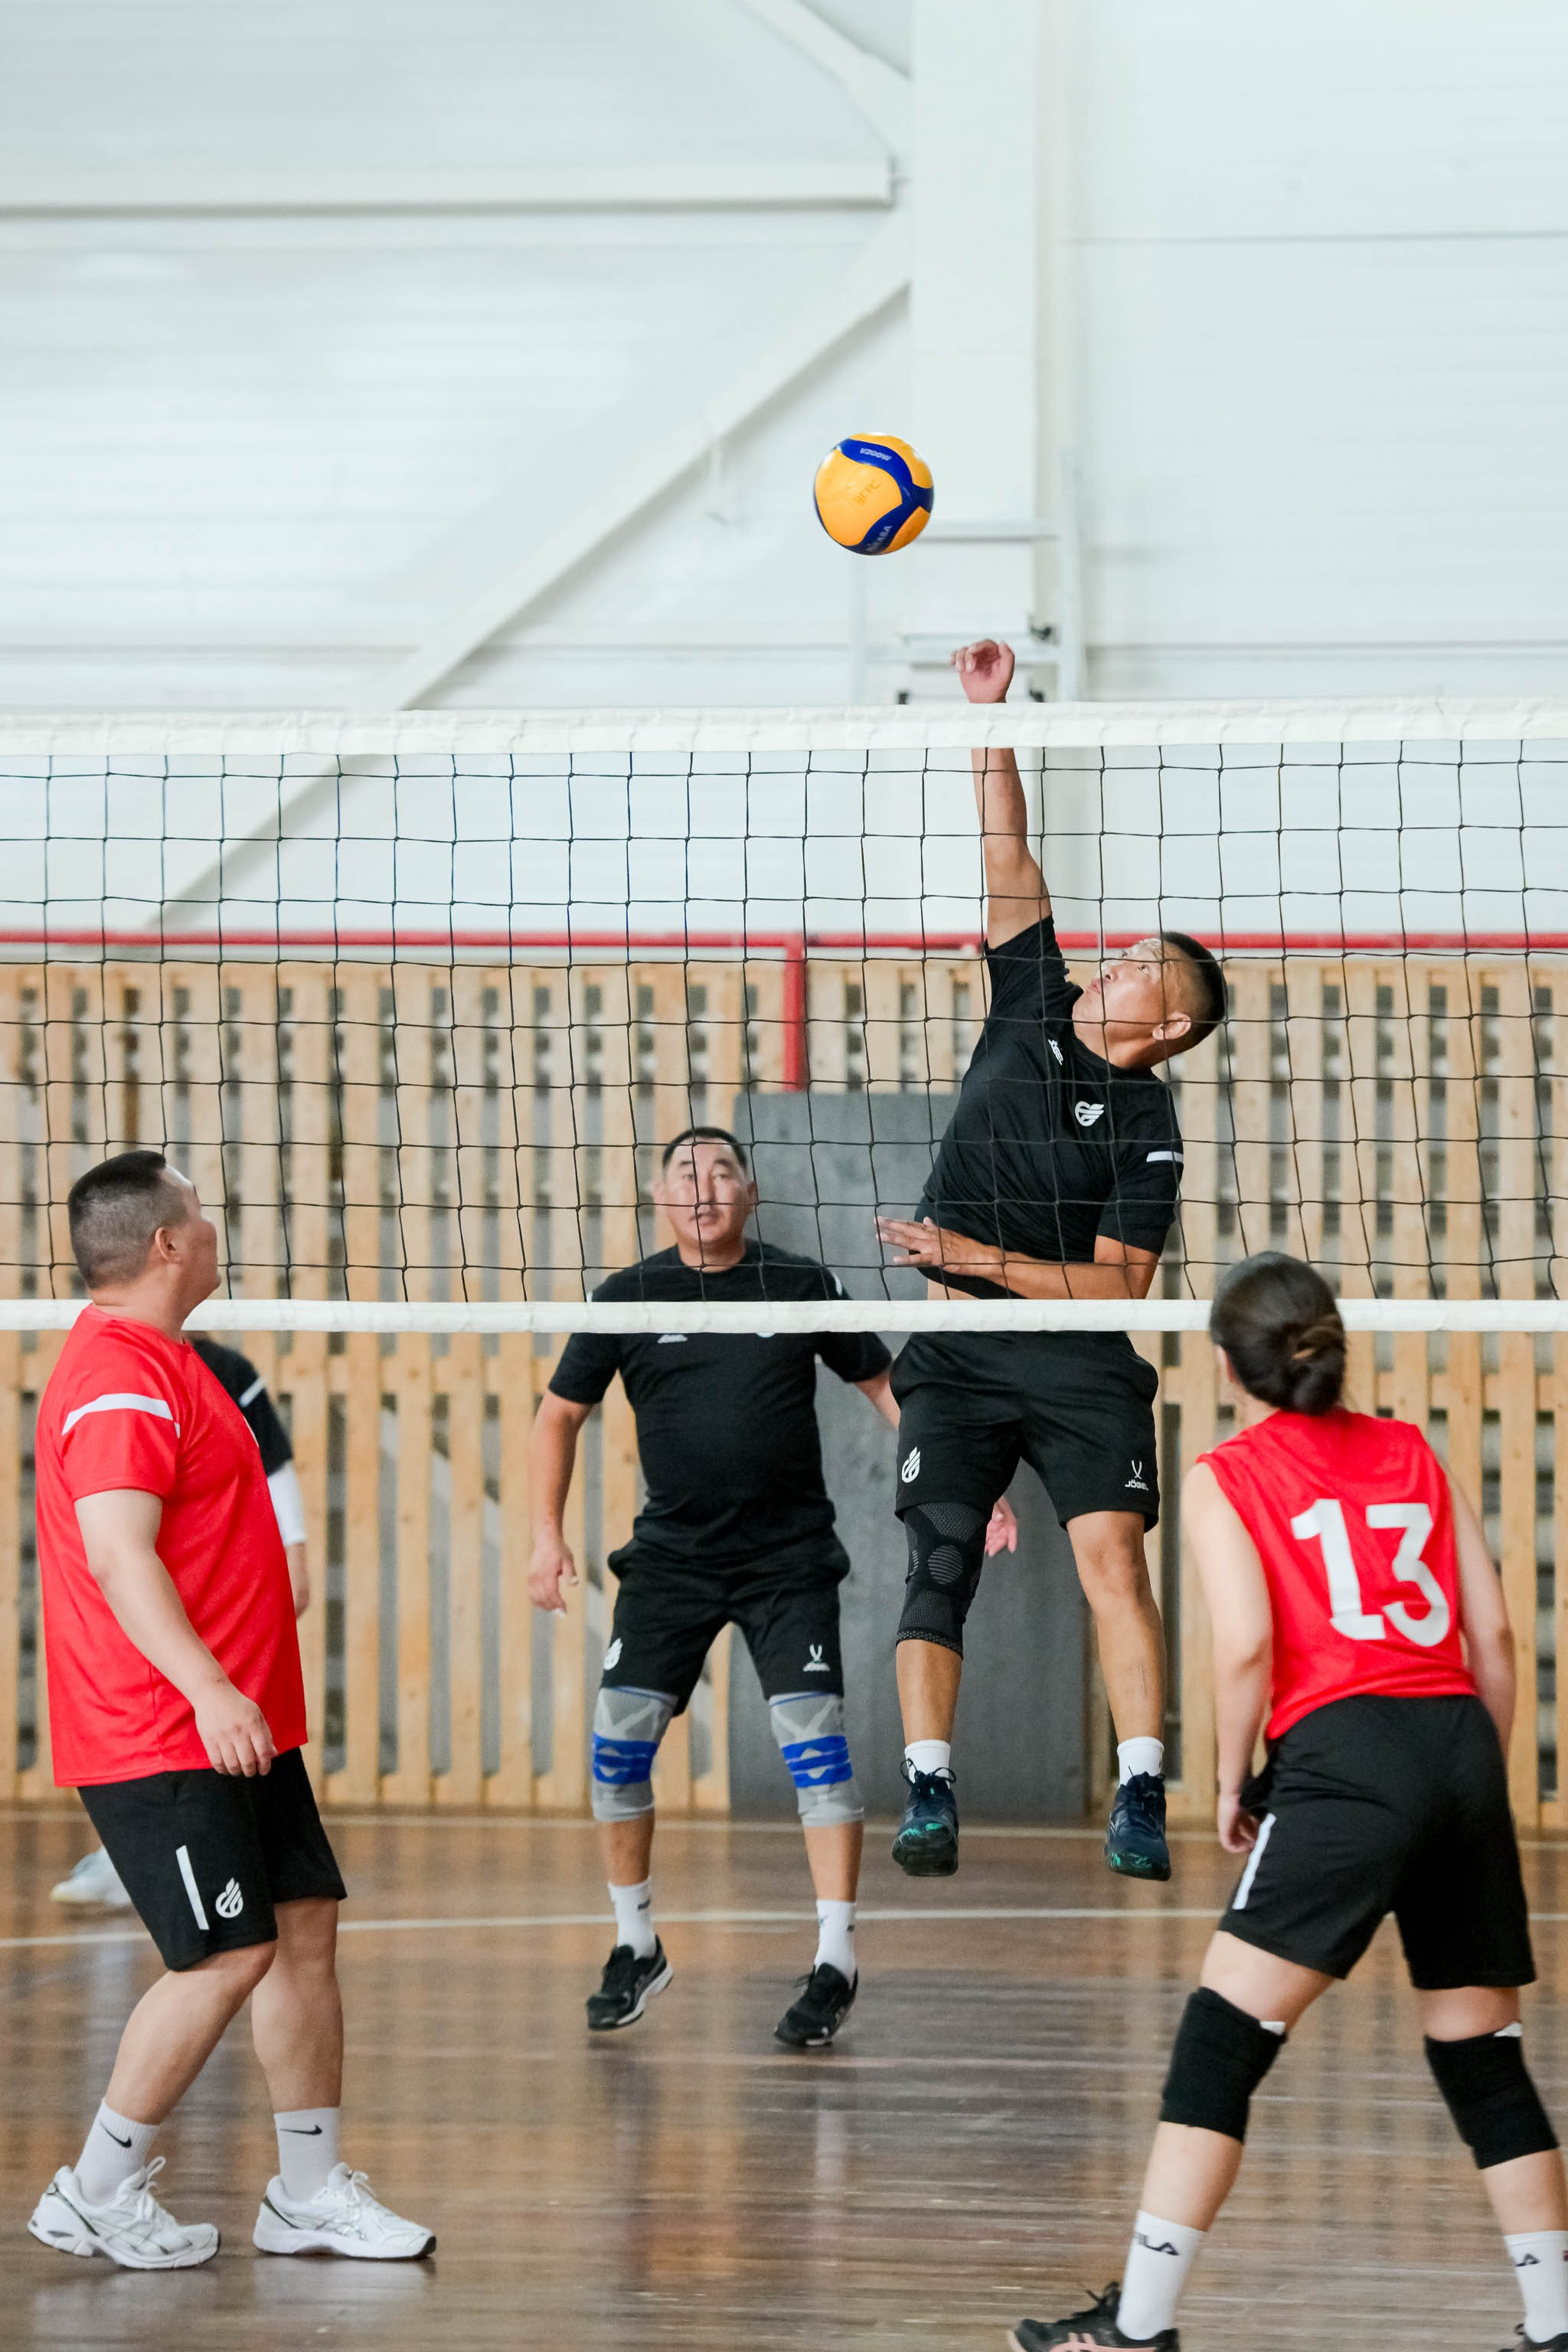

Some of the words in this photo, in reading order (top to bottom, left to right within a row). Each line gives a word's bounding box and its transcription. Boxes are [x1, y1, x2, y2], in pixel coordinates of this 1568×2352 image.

[860, 447, 892, 461] V200W
[1125, 1478, 1149, 1491] JÖGEL
[1290, 1498, 1450, 1648] 13
